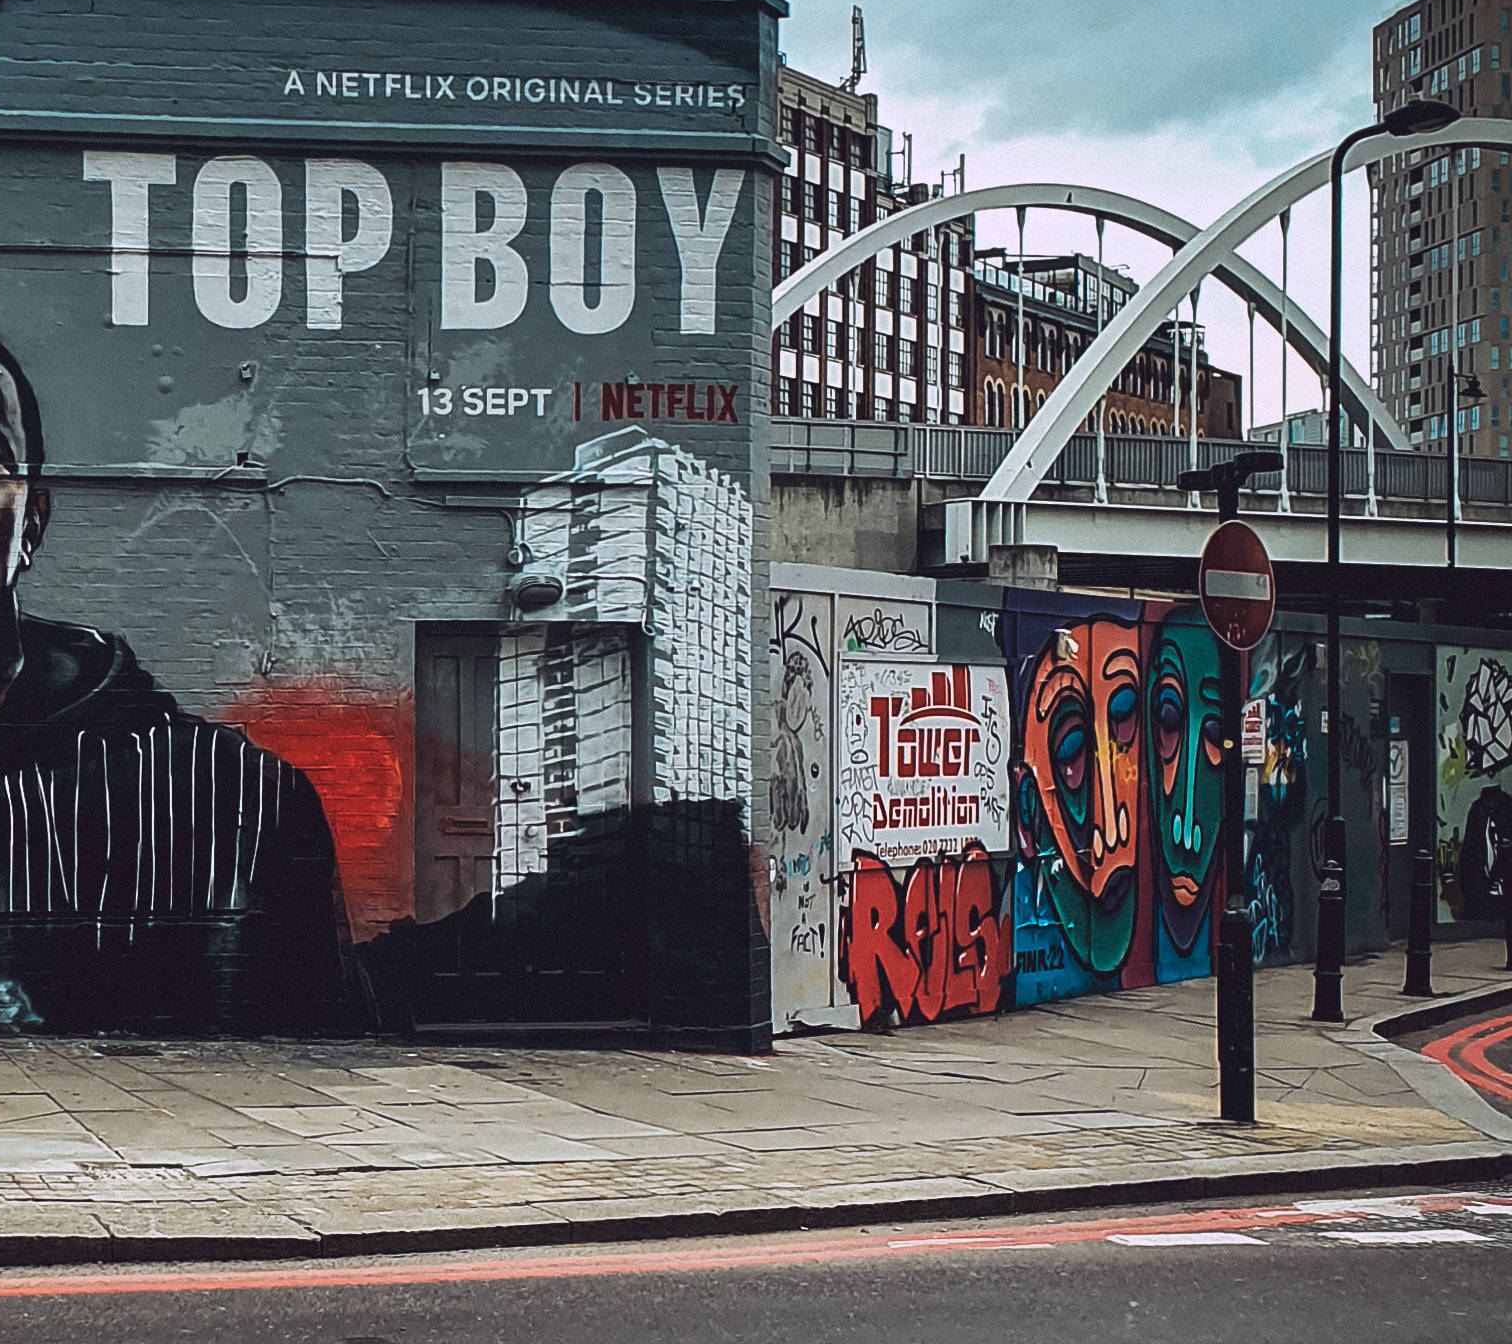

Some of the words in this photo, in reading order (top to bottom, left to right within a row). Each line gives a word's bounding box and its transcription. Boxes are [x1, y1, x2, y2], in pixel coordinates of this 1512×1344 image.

[283, 70, 305, 96] A
[316, 72, 456, 101] NETFLIX
[466, 76, 624, 105] ORIGINAL
[633, 84, 746, 108] SERIES
[83, 150, 393, 330] TOP
[440, 161, 746, 335] BOY
[417, 387, 453, 416] 13
[462, 386, 553, 417] SEPT
[600, 381, 740, 423] NETFLIX
